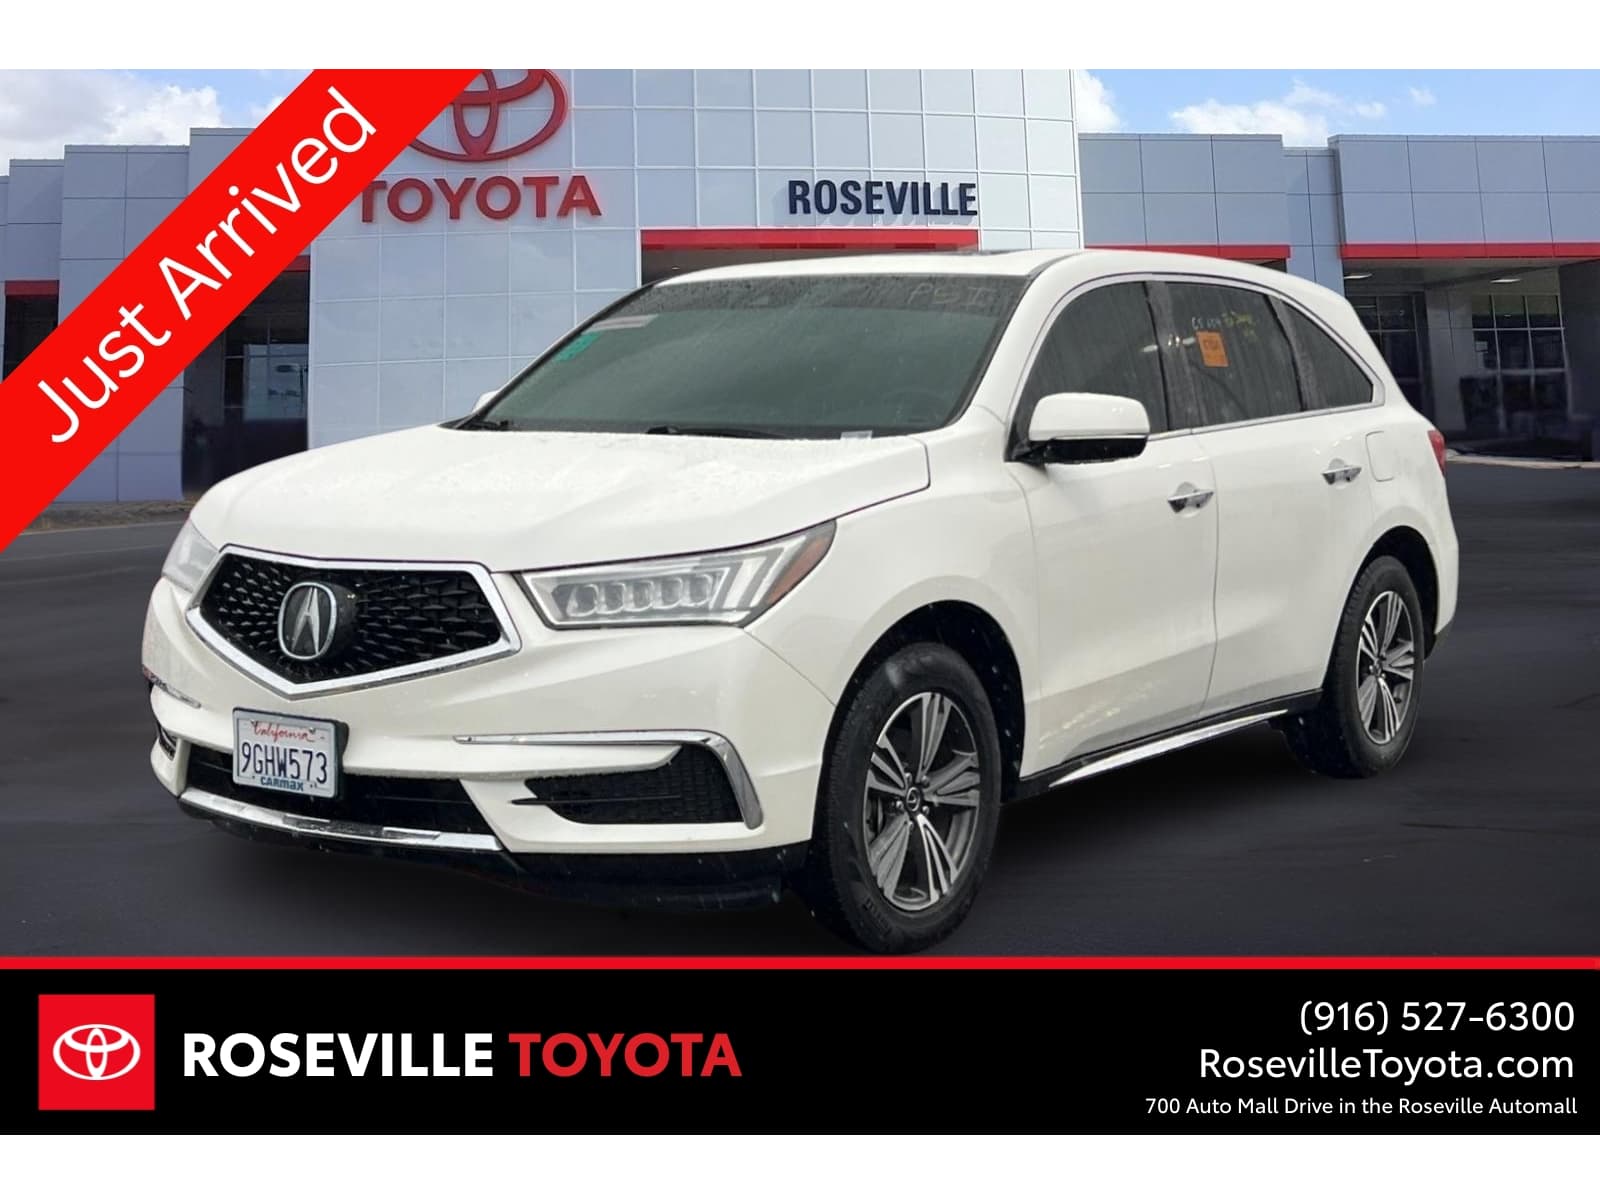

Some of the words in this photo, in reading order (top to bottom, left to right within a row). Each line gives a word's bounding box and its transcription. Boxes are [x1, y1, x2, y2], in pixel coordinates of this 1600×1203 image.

[361, 175, 602, 223] TOYOTA
[788, 179, 978, 216] ROSEVILLE
[251, 720, 315, 742] California
[241, 741, 328, 784] 9GHW573
